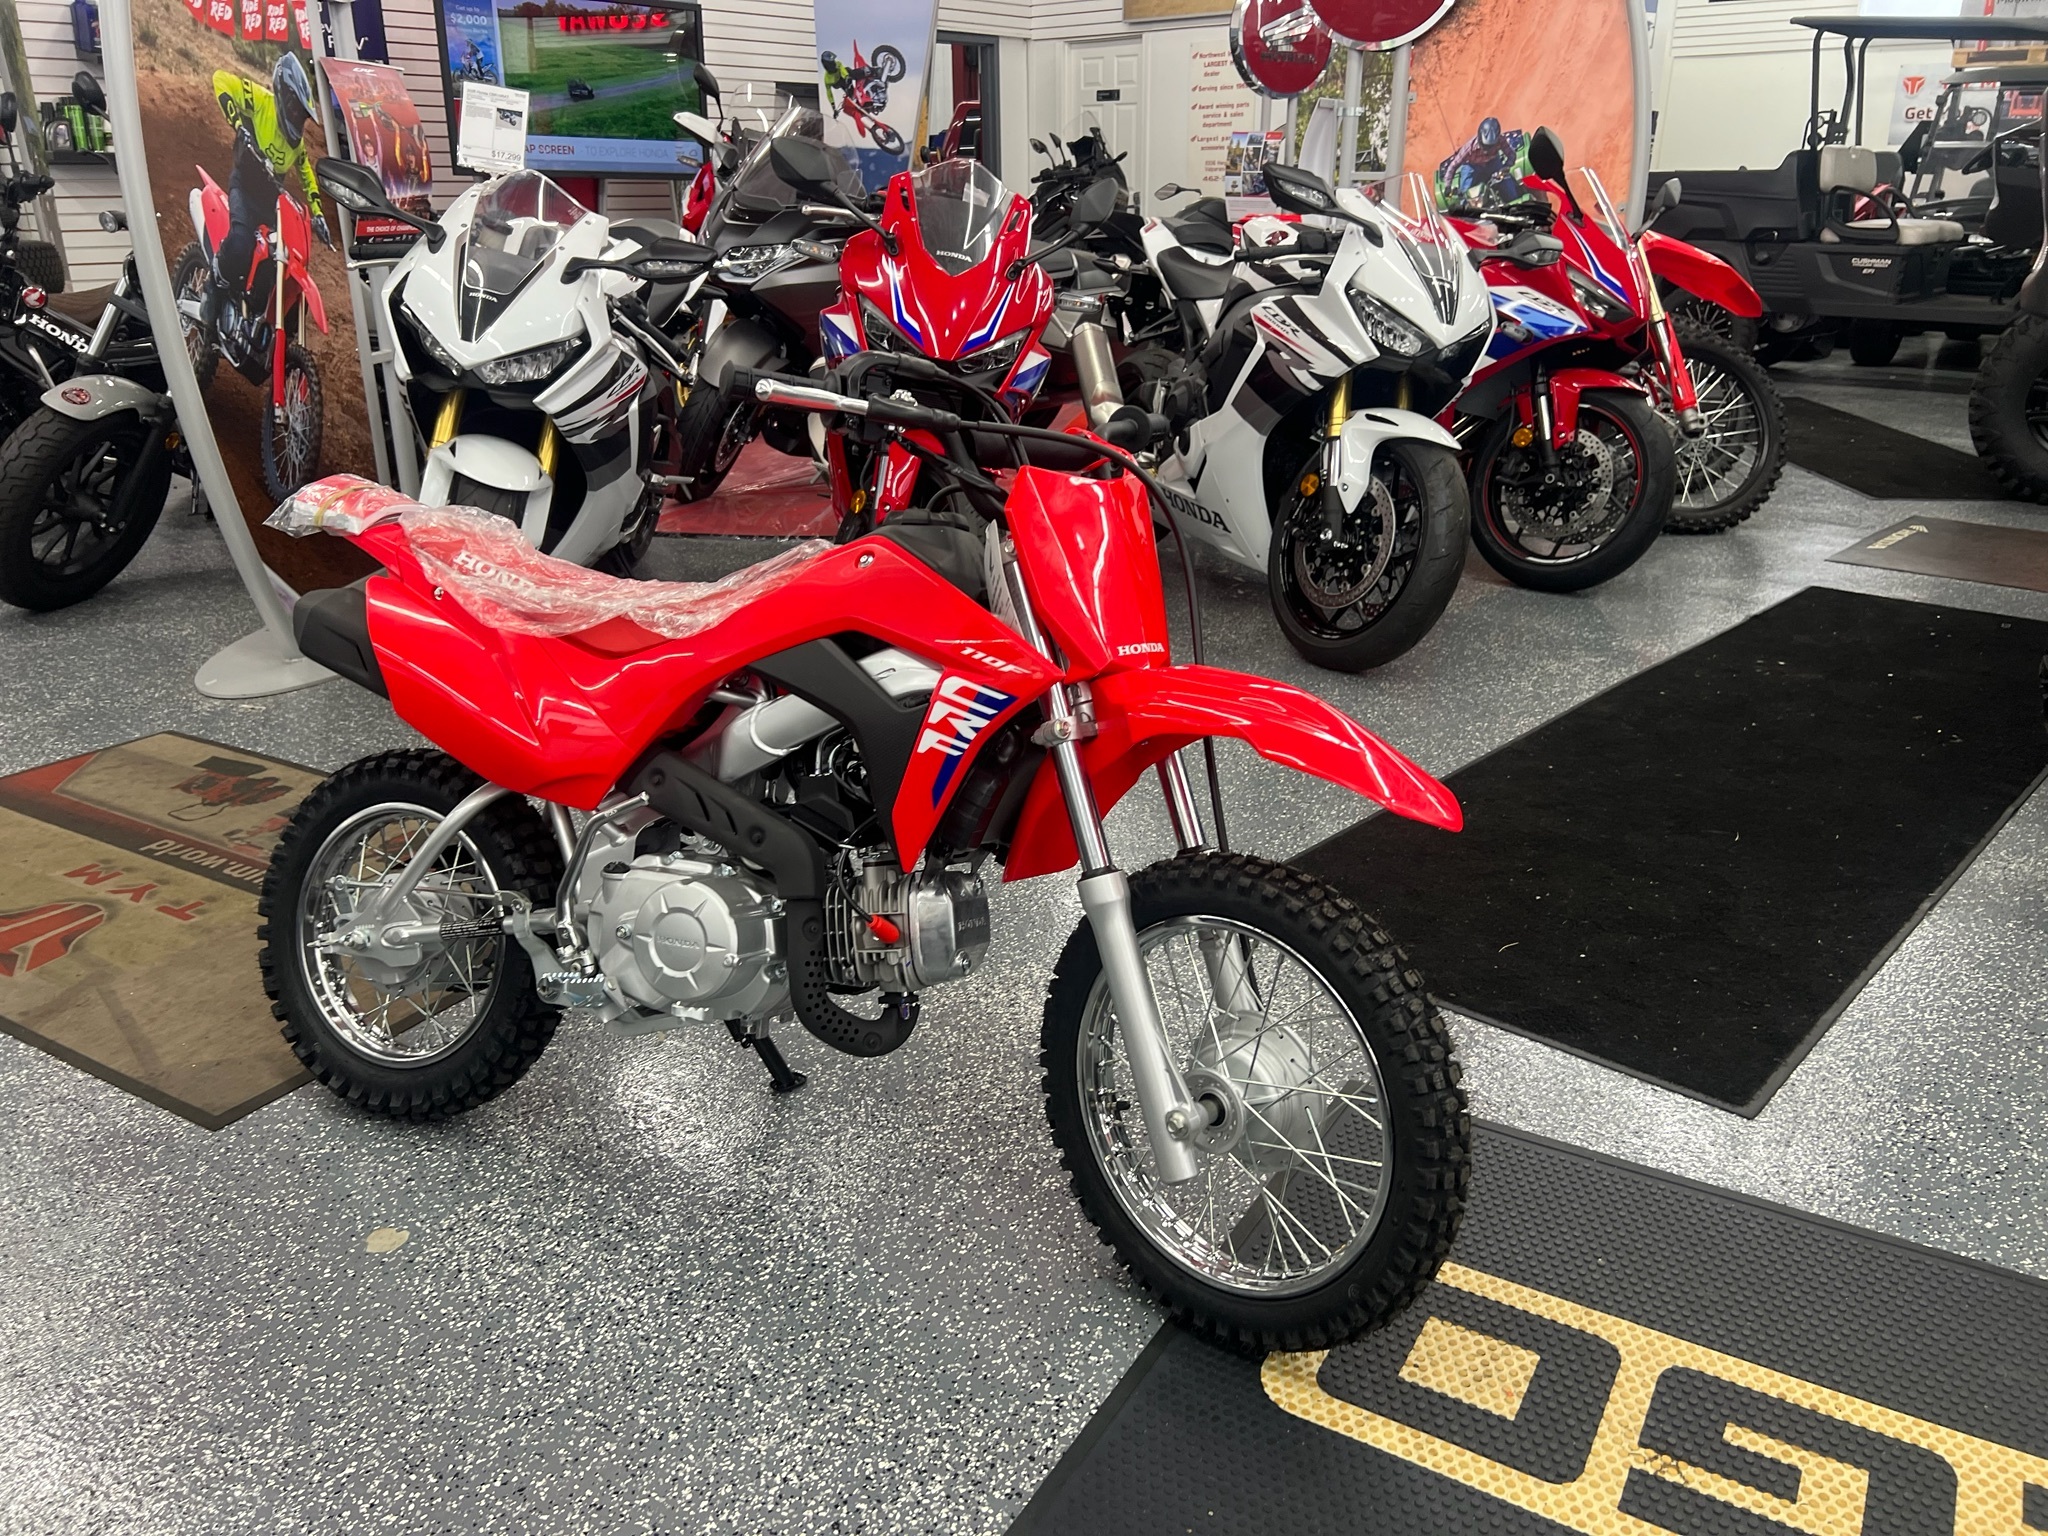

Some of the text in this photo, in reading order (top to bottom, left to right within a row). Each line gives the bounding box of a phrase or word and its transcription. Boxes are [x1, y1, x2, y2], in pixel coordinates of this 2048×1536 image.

[267, 3, 285, 16] RIDE
[245, 13, 262, 33] RED
[269, 17, 287, 34] RED
[450, 12, 488, 26] $2,000
[1905, 107, 1933, 120] Get
[491, 150, 521, 162] $17,299
[538, 145, 575, 155] SCREEN
[936, 249, 973, 263] HONDA
[1851, 257, 1892, 265] CUSHMAN
[469, 291, 498, 303] HONDA
[1261, 305, 1300, 339] CBR
[28, 313, 89, 353] HOND
[606, 363, 642, 399] CBR
[1160, 486, 1232, 534] HONDA
[1117, 642, 1166, 657] HONDA
[960, 646, 1033, 674] 110F
[917, 675, 1009, 757] CRF
[656, 934, 701, 950] HONDA
